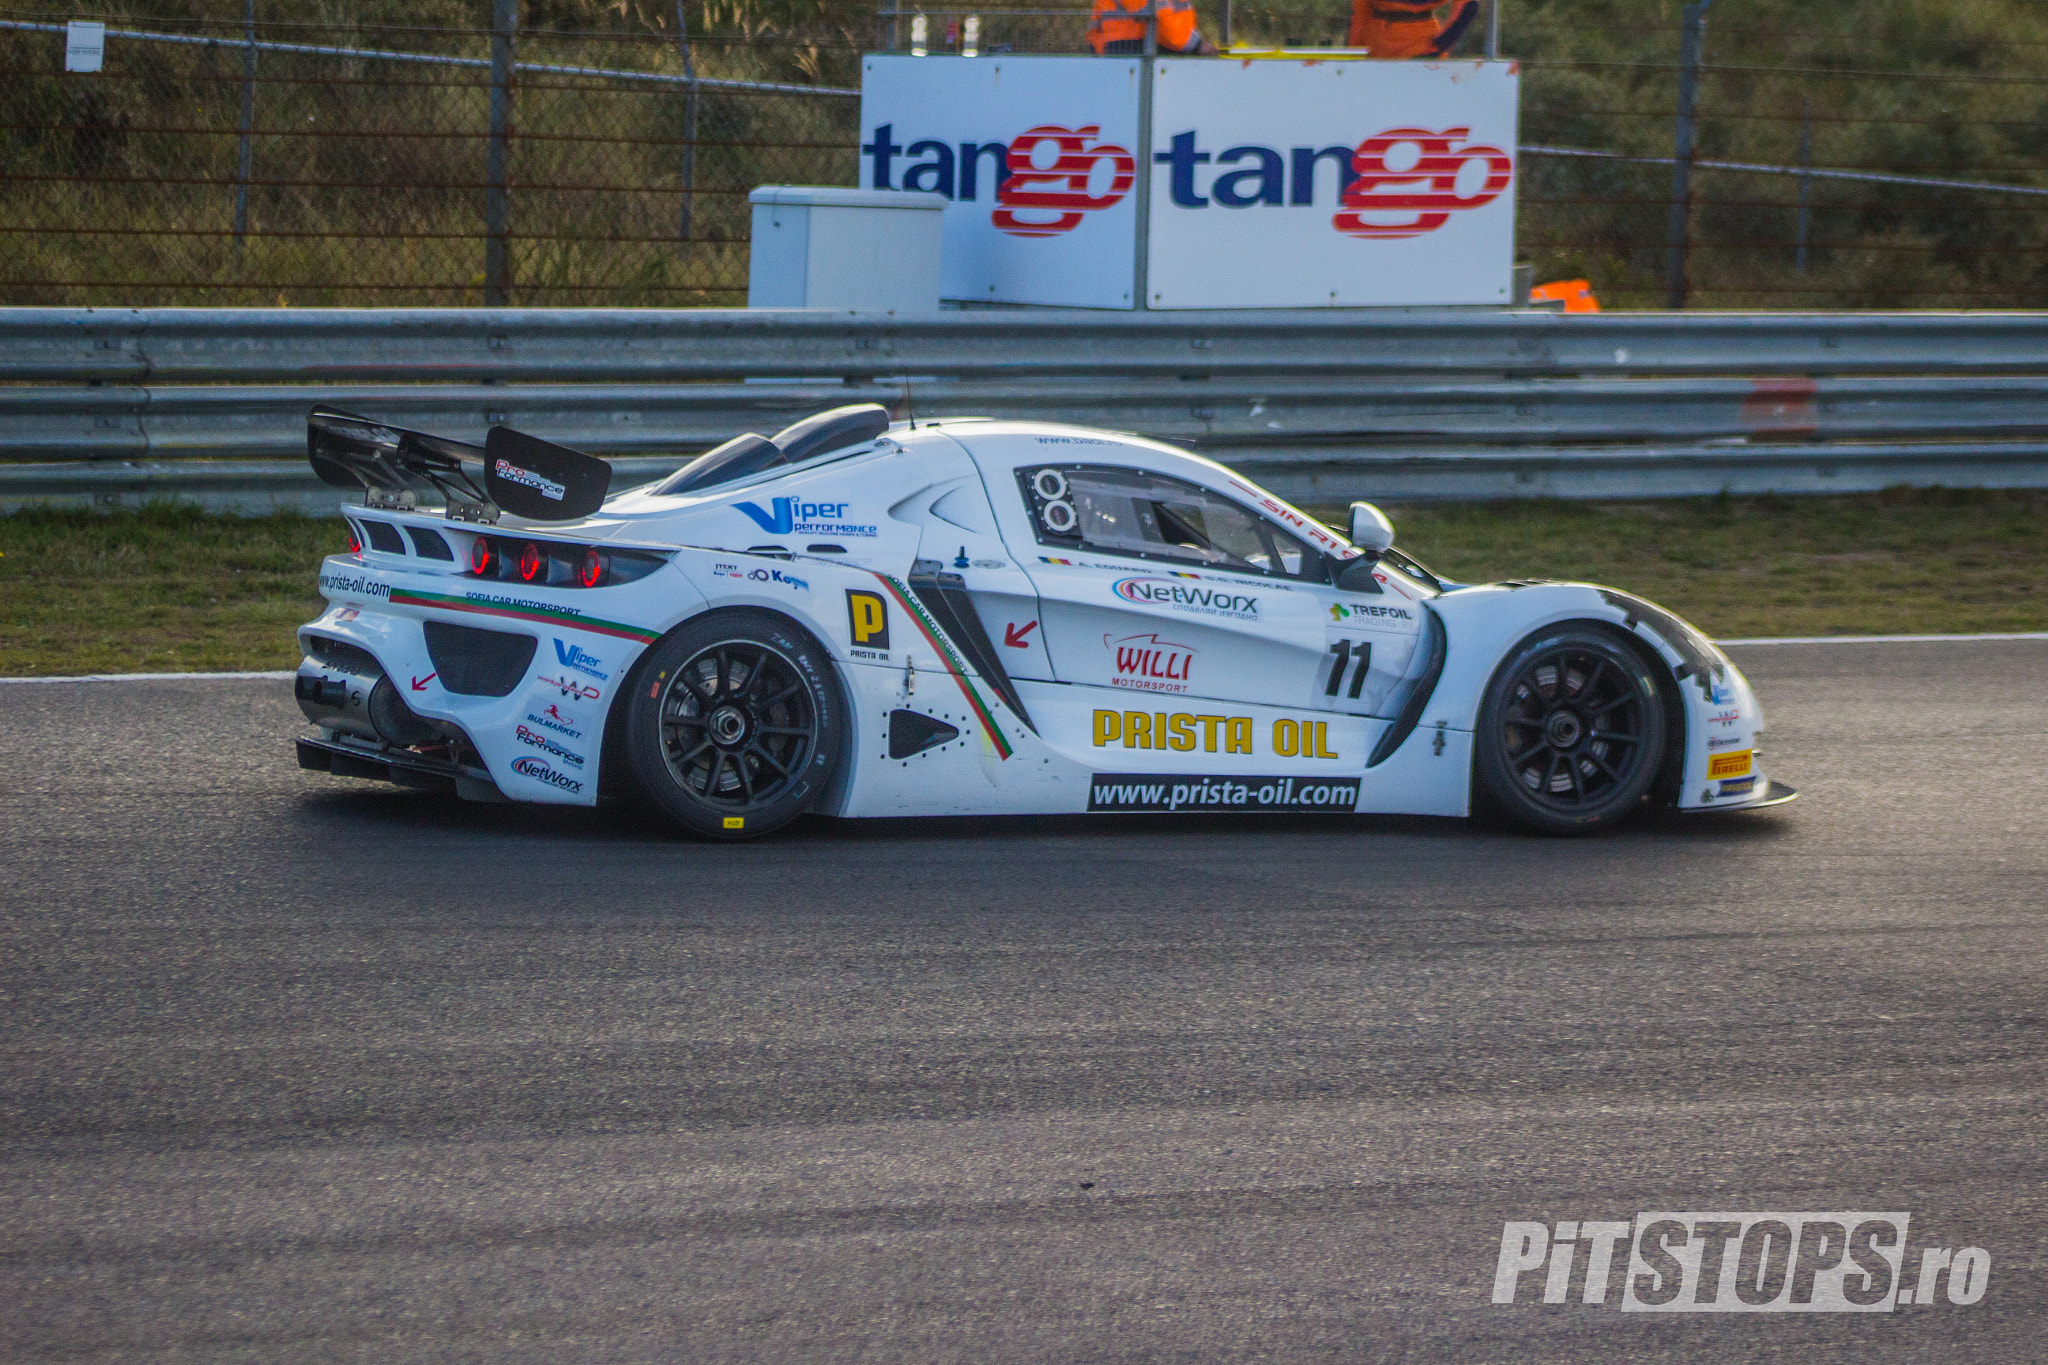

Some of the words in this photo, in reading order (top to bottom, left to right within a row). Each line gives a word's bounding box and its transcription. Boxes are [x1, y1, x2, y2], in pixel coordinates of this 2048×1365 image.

[861, 123, 1136, 238] tango
[1153, 127, 1512, 240] tango
[496, 460, 526, 477] Pro
[728, 496, 849, 535] Viper
[1259, 499, 1304, 528] SIN
[1308, 528, 1338, 549] R1
[466, 592, 490, 602] SOFIA
[492, 595, 512, 605] CAR
[513, 598, 582, 617] MOTORSPORT
[1127, 582, 1257, 614] NetWorx
[1349, 604, 1412, 619] TREFOIL
[851, 595, 883, 642] P
[909, 593, 926, 616] CAR
[923, 613, 968, 673] MOTORSPORT
[1353, 615, 1396, 628] TRADING
[553, 638, 601, 668] Viper
[850, 650, 876, 659] PRISTA
[878, 653, 890, 661] OIL
[1116, 647, 1192, 680] WILLI
[1325, 639, 1372, 699] 11
[1111, 678, 1188, 693] MOTORSPORT
[516, 724, 546, 744] Pro
[527, 713, 582, 739] BULMARKET
[1093, 709, 1252, 754] PRISTA
[1272, 719, 1338, 759] OIL
[516, 732, 585, 765] Formance
[519, 761, 583, 792] NetWorx
[1711, 754, 1748, 776] PIRELLI
[1094, 778, 1356, 810] www.prista-oil.com
